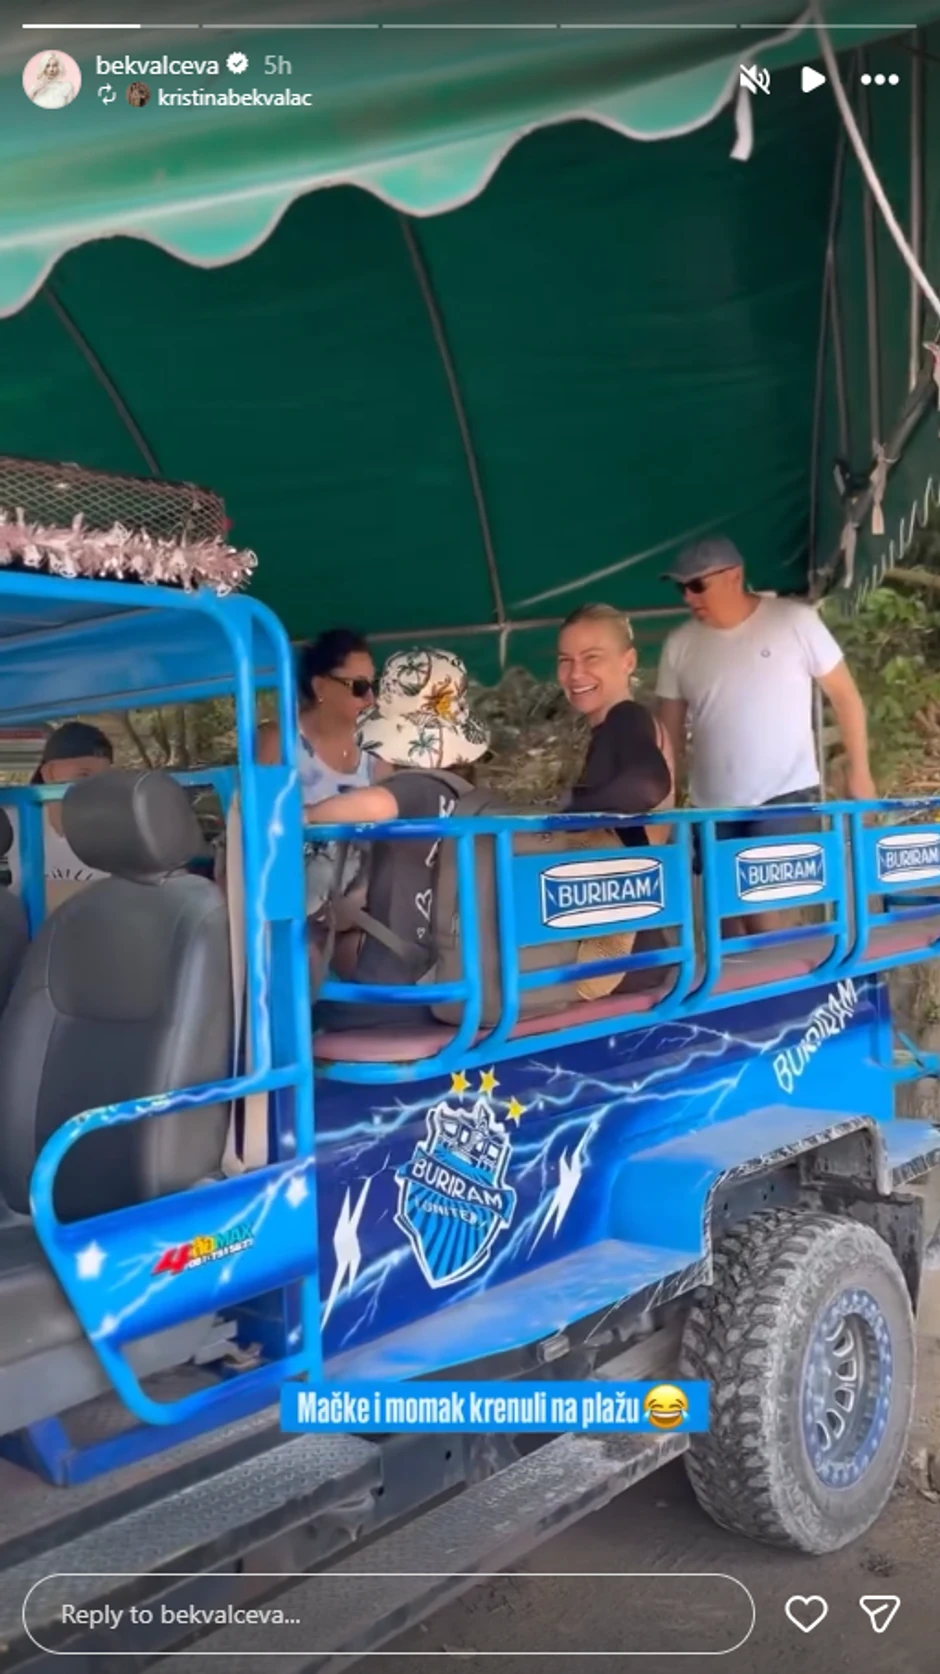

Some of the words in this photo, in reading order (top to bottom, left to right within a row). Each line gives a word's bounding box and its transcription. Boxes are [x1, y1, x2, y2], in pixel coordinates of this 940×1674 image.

[749, 860, 816, 886] BURIRAM
[886, 847, 939, 869] BURIRAM
[558, 877, 651, 908] BURIRAM
[773, 978, 858, 1094] BURIRAM
[411, 1159, 503, 1210] BURIRAM
